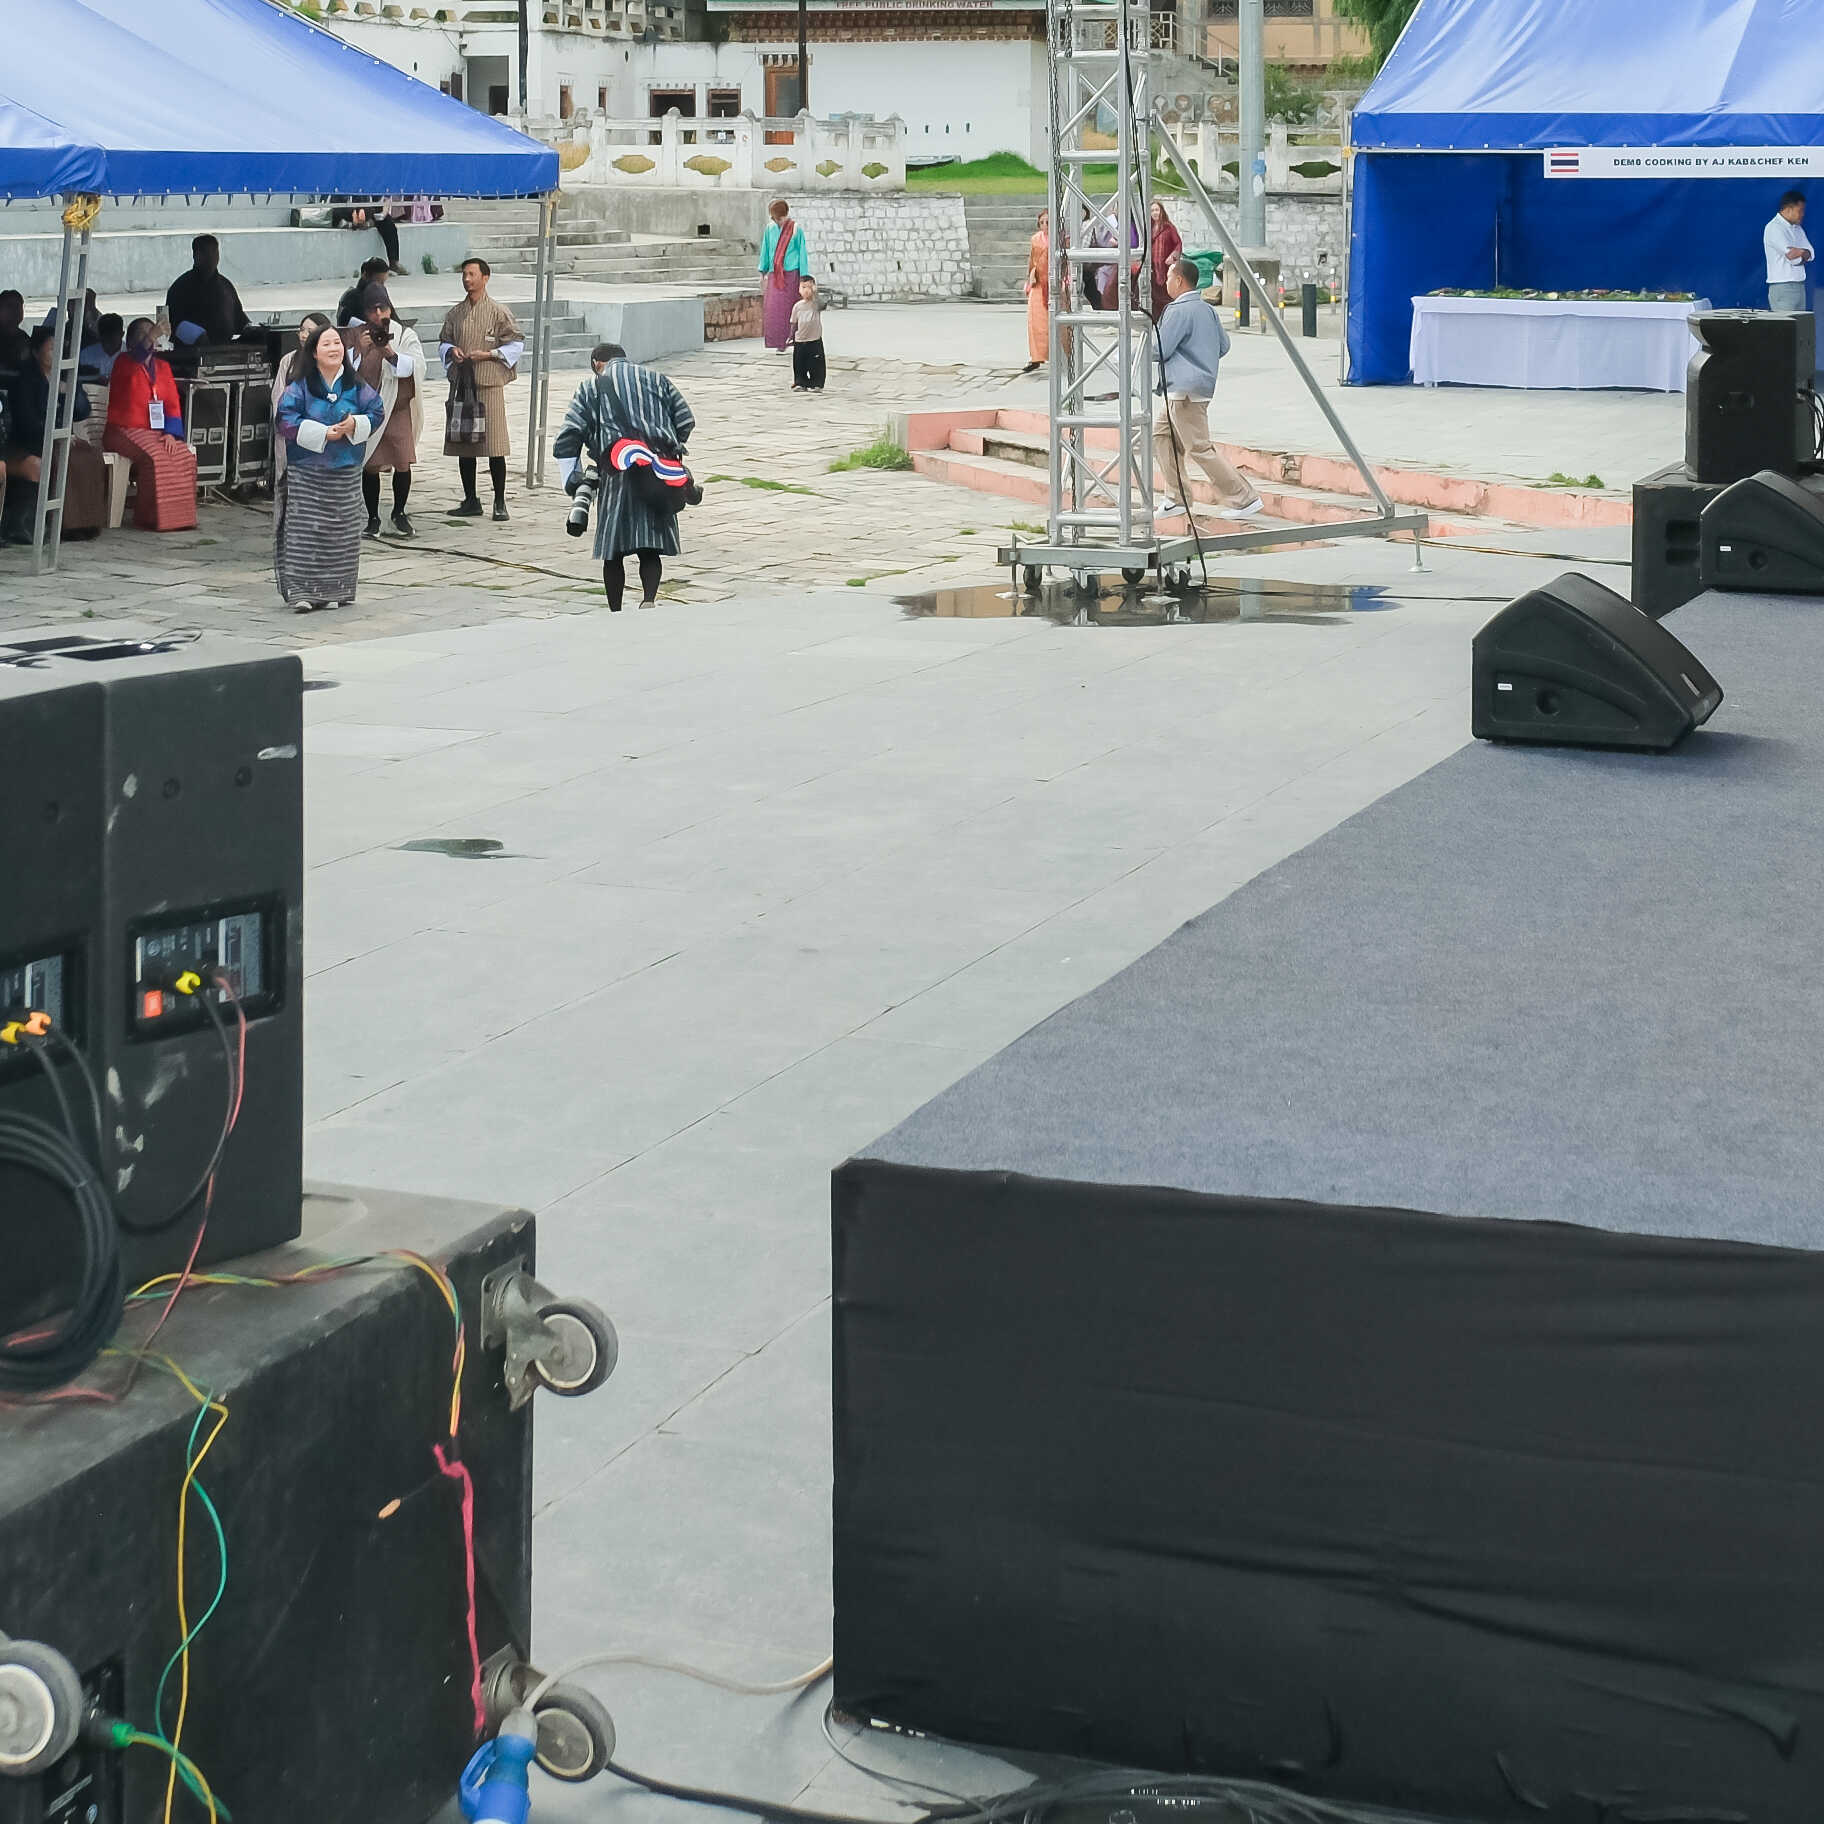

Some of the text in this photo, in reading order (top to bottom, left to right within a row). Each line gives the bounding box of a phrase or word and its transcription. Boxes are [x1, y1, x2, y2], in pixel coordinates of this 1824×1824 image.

[836, 0, 993, 9] FREE PUBLIC DRINKING WATER
[1613, 158, 1642, 166] DEMO
[1644, 158, 1692, 166] COOKING
[1695, 158, 1709, 166] BY
[1711, 158, 1725, 166] AJ
[1787, 157, 1809, 165] KEN
